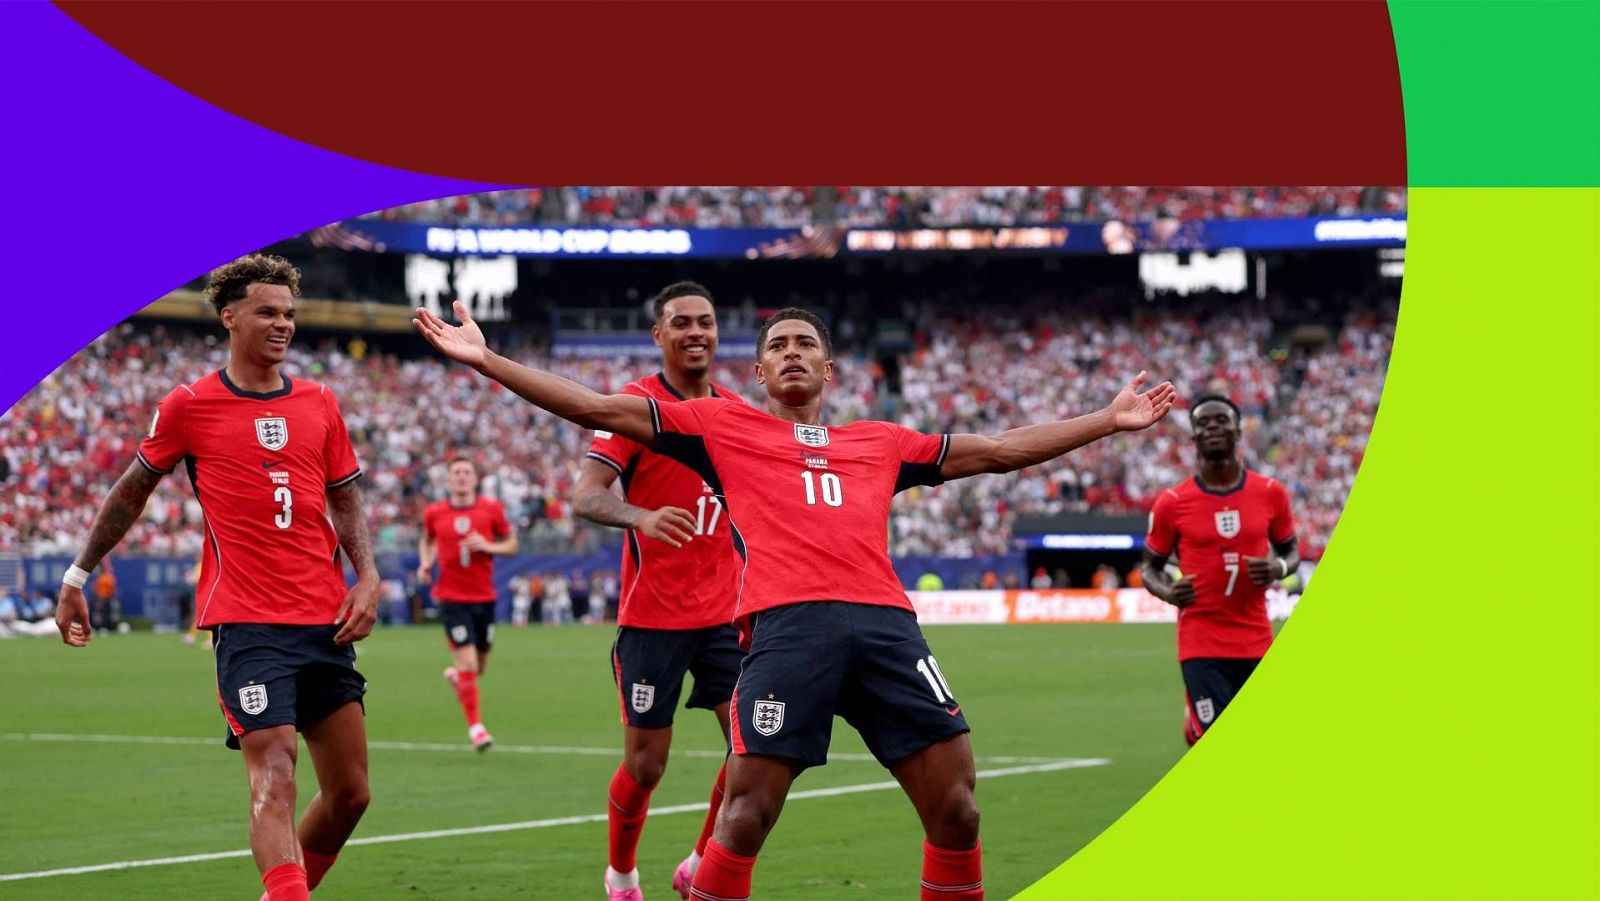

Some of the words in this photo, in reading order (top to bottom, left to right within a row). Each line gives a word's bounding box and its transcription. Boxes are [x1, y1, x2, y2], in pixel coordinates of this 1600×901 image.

[801, 470, 843, 507] 10
[274, 487, 292, 529] 3
[696, 496, 722, 535] 17
[1224, 564, 1239, 597] 7
[1016, 593, 1111, 621] Betano
[917, 655, 953, 703] 10
